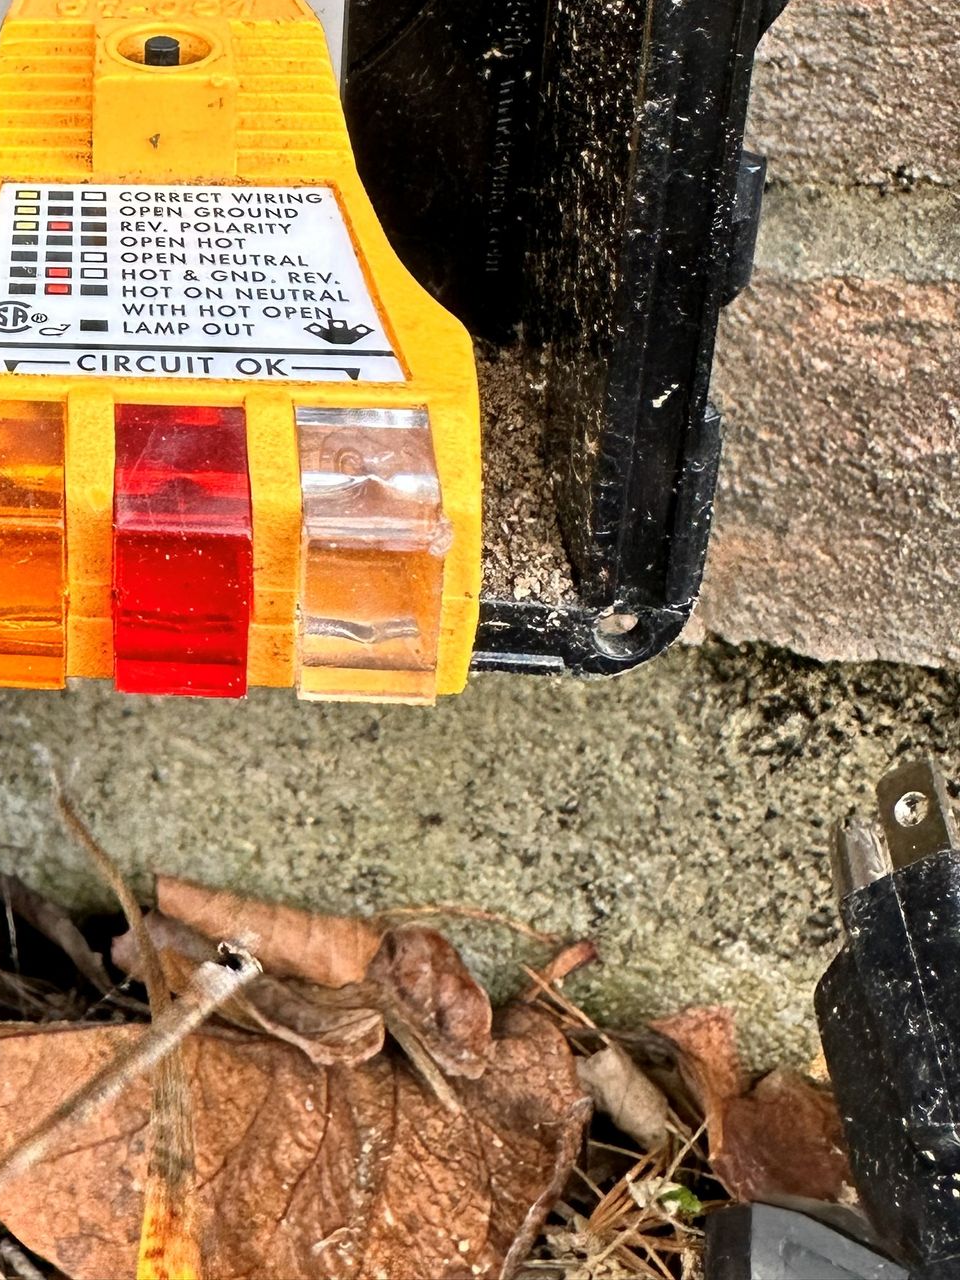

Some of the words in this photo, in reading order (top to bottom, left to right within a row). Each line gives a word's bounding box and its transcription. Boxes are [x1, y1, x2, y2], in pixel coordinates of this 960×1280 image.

[119, 190, 220, 204] CORRECT
[232, 190, 323, 206] WIRING
[119, 206, 184, 219] OPEN
[193, 206, 299, 219] GROUND
[120, 221, 168, 234] REV.
[180, 221, 292, 236] POLARITY
[120, 236, 186, 249] OPEN
[197, 237, 246, 250] HOT
[120, 251, 188, 265] OPEN
[198, 252, 310, 268] NEUTRAL
[122, 268, 173, 282] HOT
[184, 269, 198, 282] &
[210, 269, 277, 284] GND.
[289, 270, 341, 285] REV.
[122, 285, 175, 299] HOT
[184, 286, 224, 300] ON
[235, 286, 350, 304] NEUTRAL
[122, 303, 187, 318] WITH
[199, 303, 253, 319] HOT
[265, 305, 333, 320] OPEN
[123, 321, 189, 336] LAMP
[202, 322, 256, 338] OUT
[77, 354, 213, 374] CIRCUIT
[235, 357, 289, 376] OK
